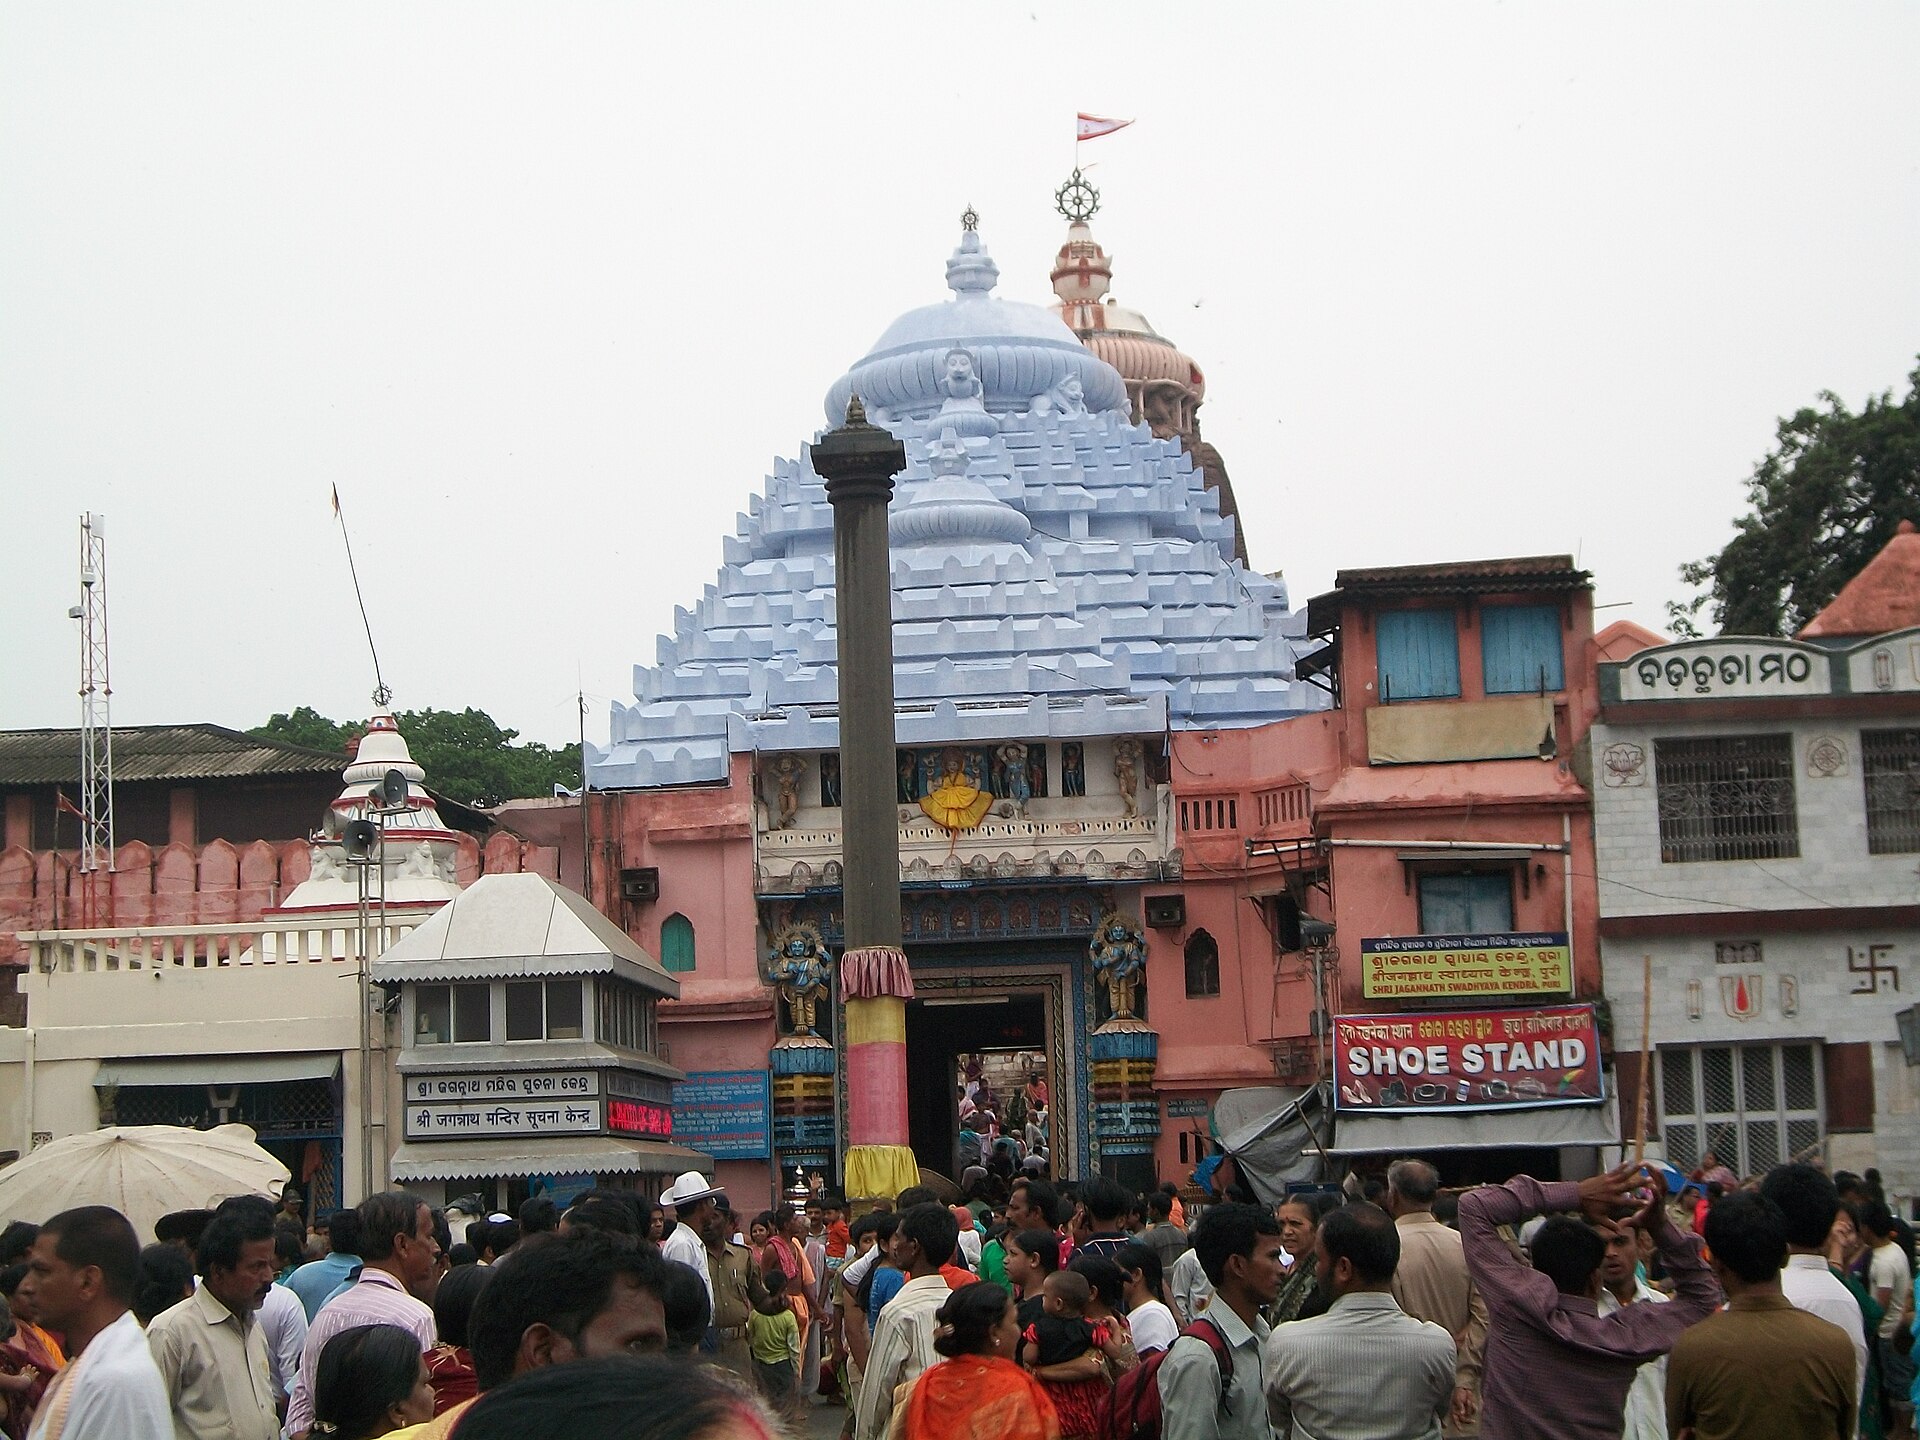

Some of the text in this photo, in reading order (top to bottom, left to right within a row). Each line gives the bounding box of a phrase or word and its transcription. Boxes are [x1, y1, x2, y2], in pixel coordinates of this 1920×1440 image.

[1759, 652, 1812, 683] ମଠ
[1372, 984, 1393, 994] SHRI
[1395, 983, 1446, 995] JAGANNATH
[1448, 981, 1500, 992] SWADHYAYA
[1541, 980, 1561, 989] PURI
[1347, 1038, 1588, 1076] SHOE STAND
[416, 1109, 431, 1128] श्री
[436, 1112, 481, 1127] जगन्नाथ
[485, 1107, 520, 1126] मन्दिर
[526, 1110, 560, 1129] सूचना
[564, 1105, 592, 1124] केन्द्र
